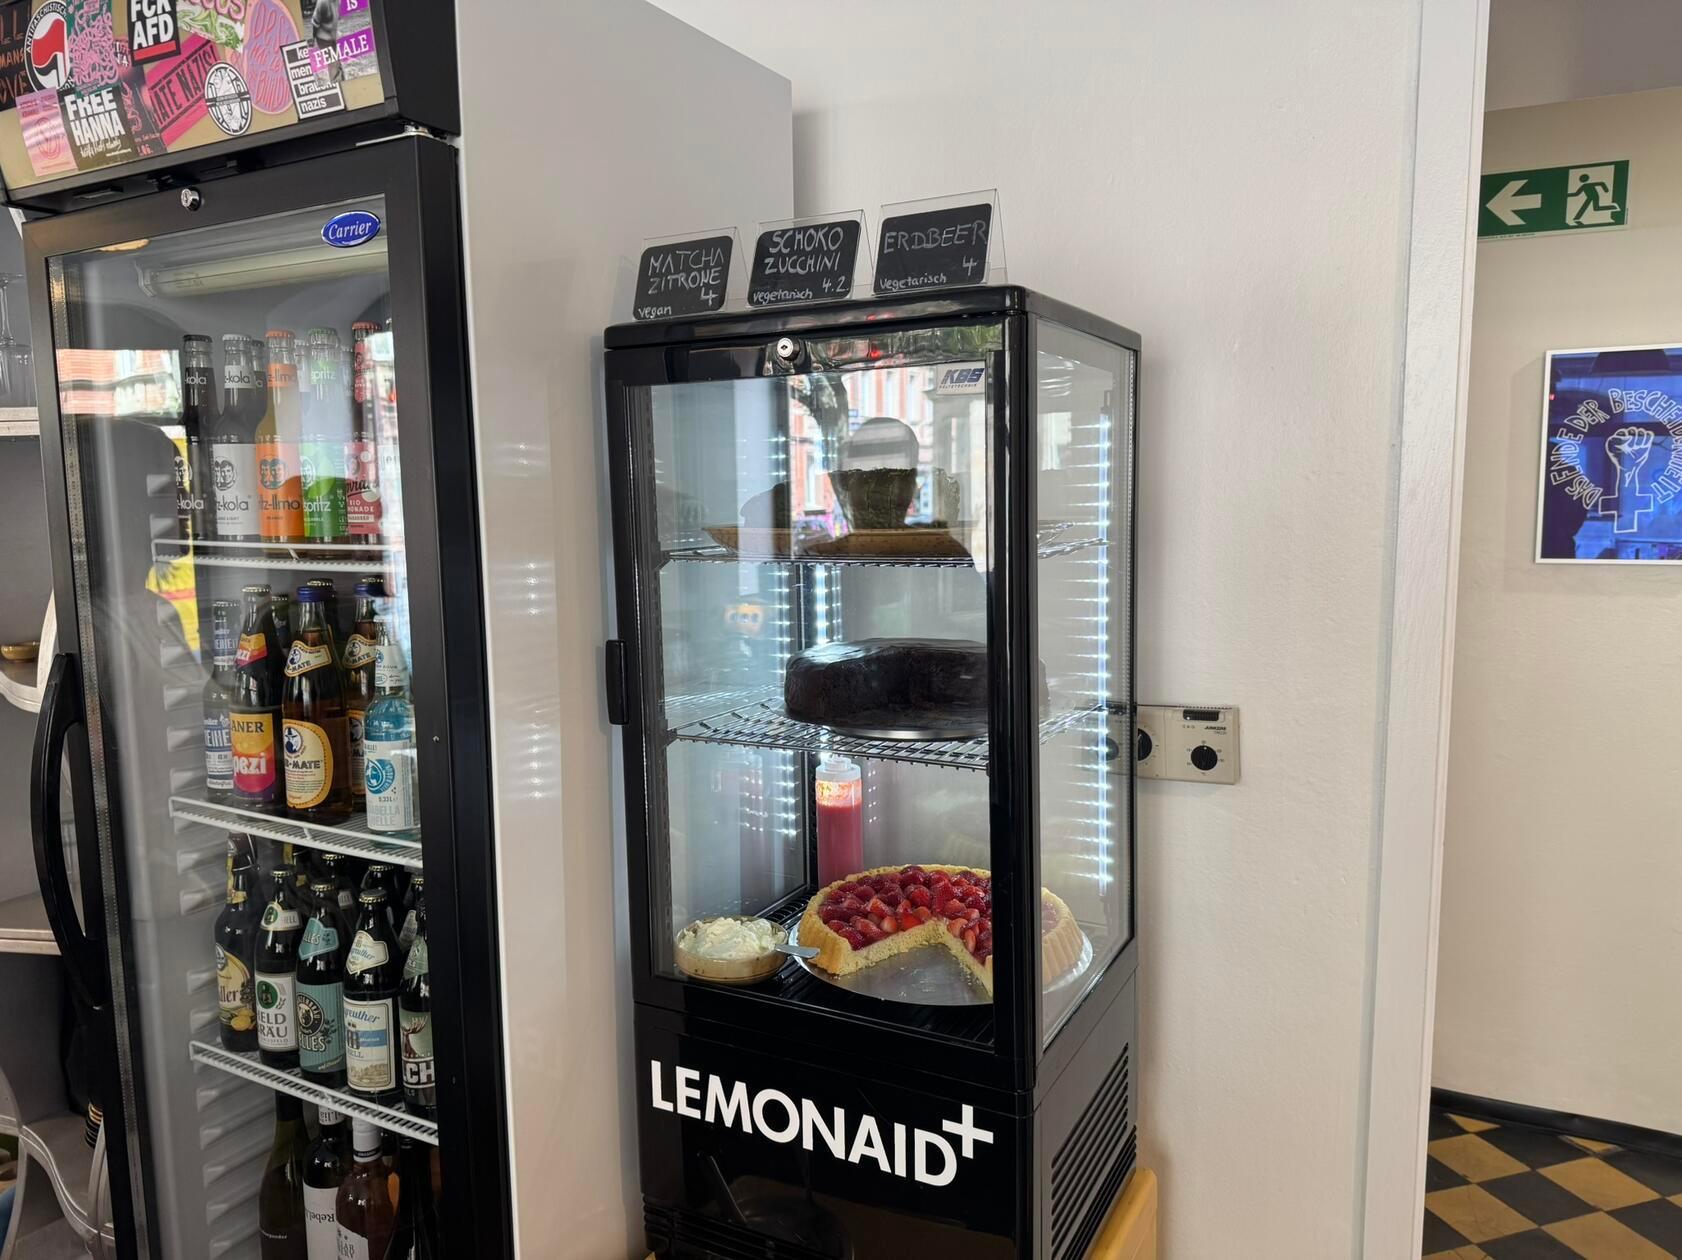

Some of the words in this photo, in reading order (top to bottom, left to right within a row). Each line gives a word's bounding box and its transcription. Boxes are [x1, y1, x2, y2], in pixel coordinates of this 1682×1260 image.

[133, 13, 174, 50] AFD
[314, 34, 370, 67] FEMALE
[64, 87, 118, 120] FREE
[301, 97, 327, 113] nazis
[70, 110, 126, 146] HANNA
[327, 218, 373, 244] Carrier
[769, 226, 843, 254] SCHOKO
[883, 219, 988, 254] ERDBEER
[648, 247, 724, 276] MATCHA
[764, 251, 841, 275] ZUCCHINI
[962, 255, 977, 277] 4
[648, 266, 722, 295] ZITRONE
[700, 288, 719, 307] 4
[638, 305, 672, 319] vegan
[941, 367, 985, 385] KBS
[1564, 399, 1610, 432] DER
[1551, 428, 1584, 486] ENDE
[232, 721, 264, 733] ANER
